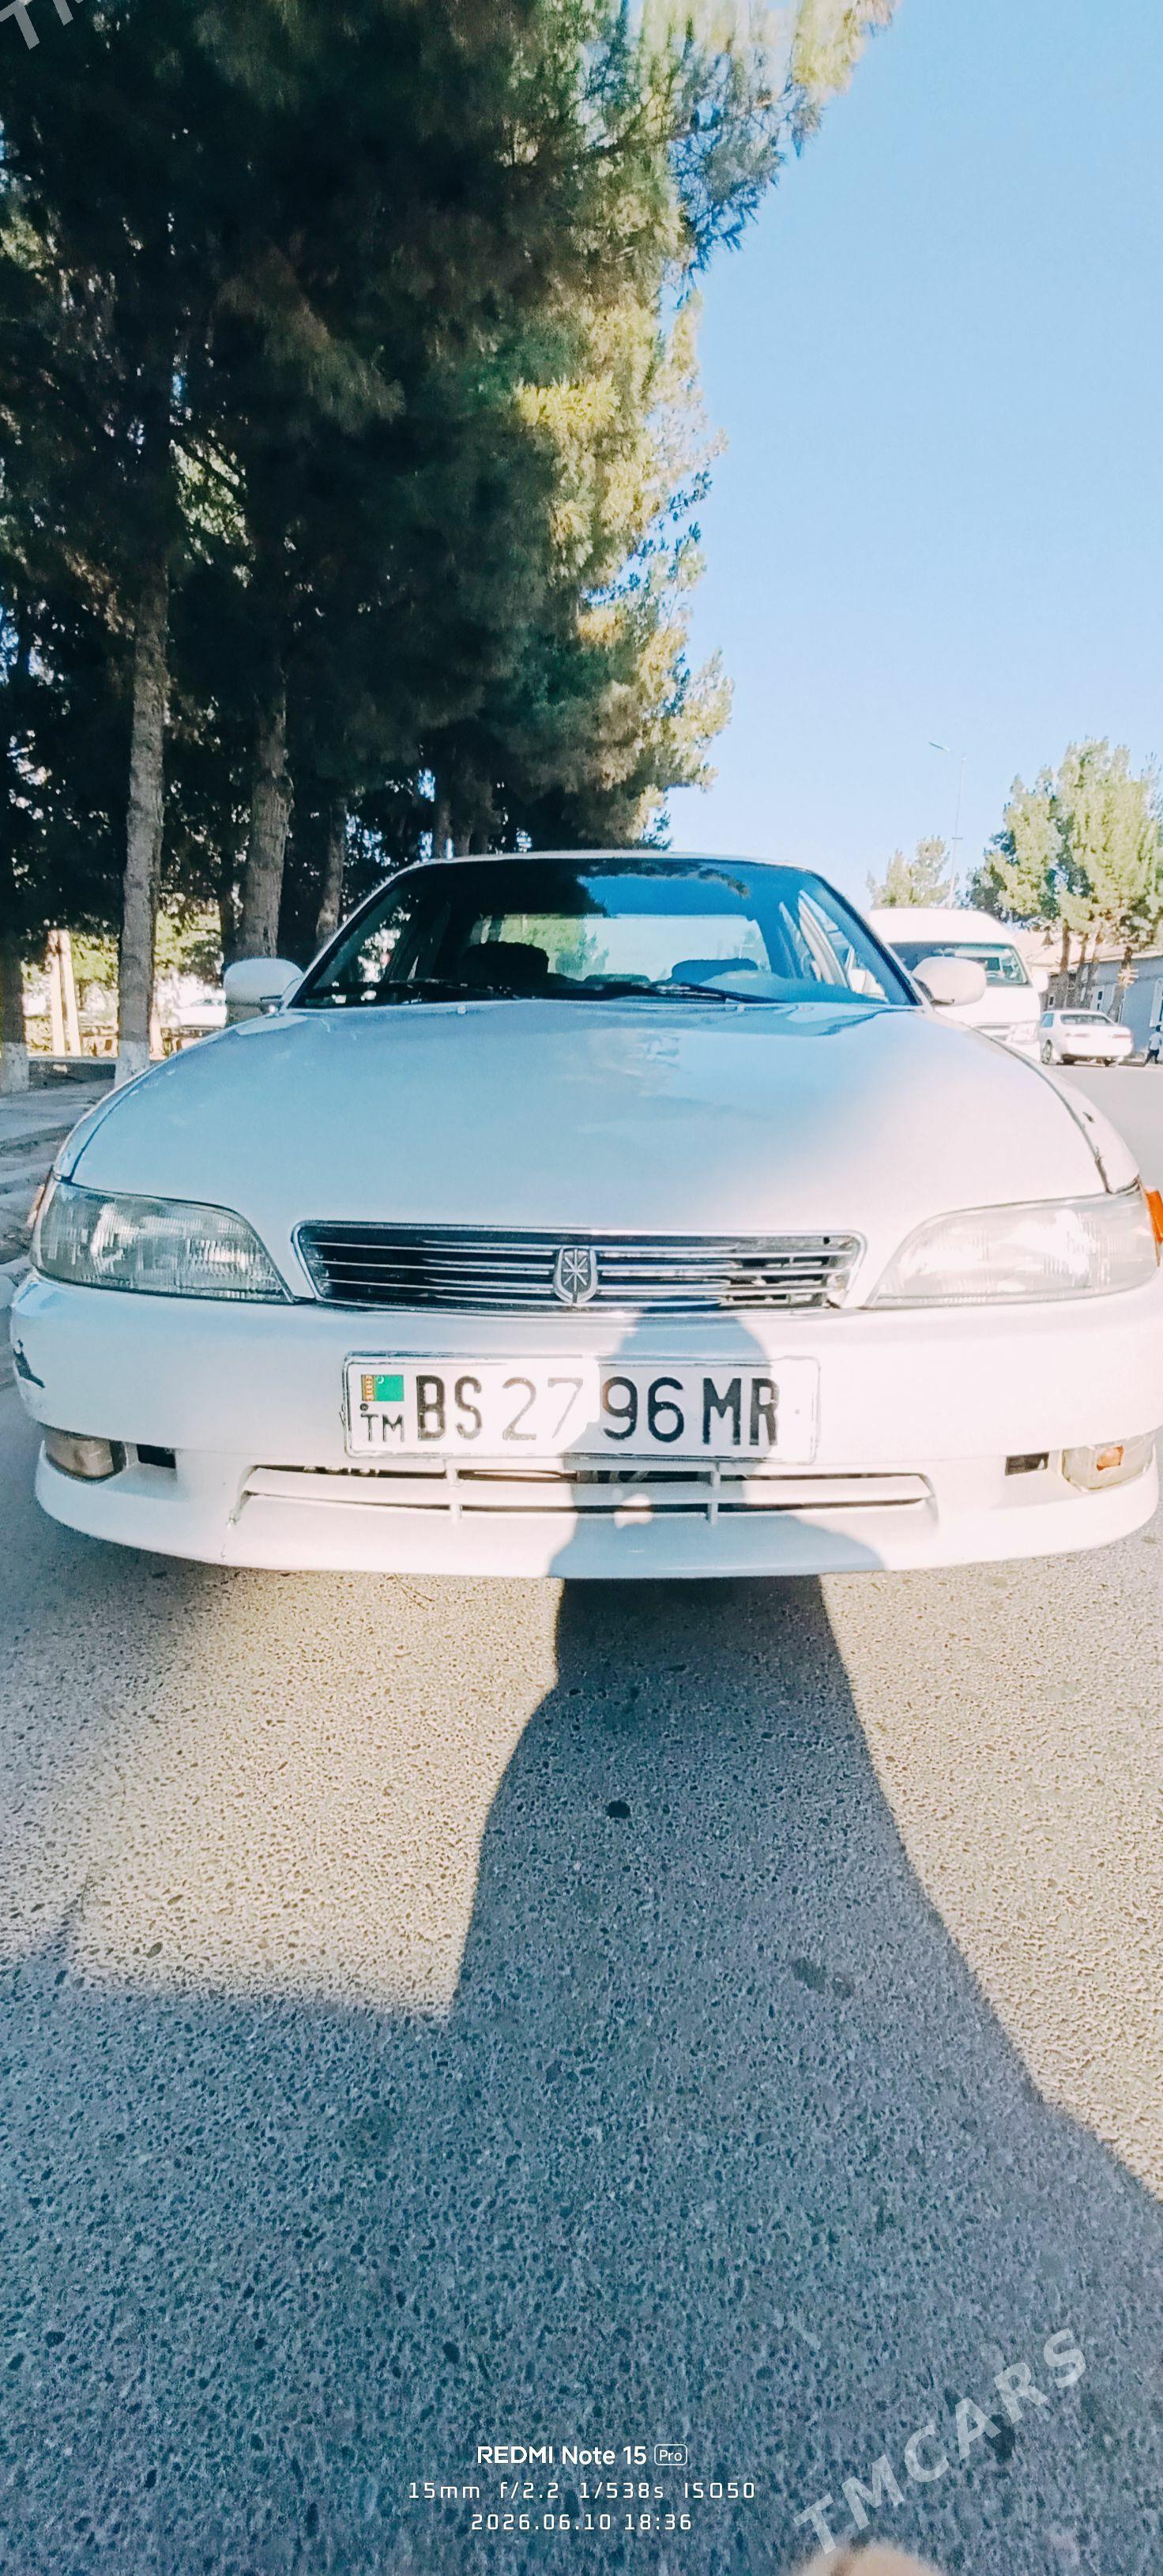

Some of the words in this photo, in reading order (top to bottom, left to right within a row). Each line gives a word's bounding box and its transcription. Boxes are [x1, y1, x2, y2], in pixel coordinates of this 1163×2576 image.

[360, 1412, 405, 1443] TM
[416, 1375, 484, 1442] BS
[502, 1377, 584, 1441] 27
[601, 1376, 686, 1443] 96
[702, 1377, 781, 1447] MR
